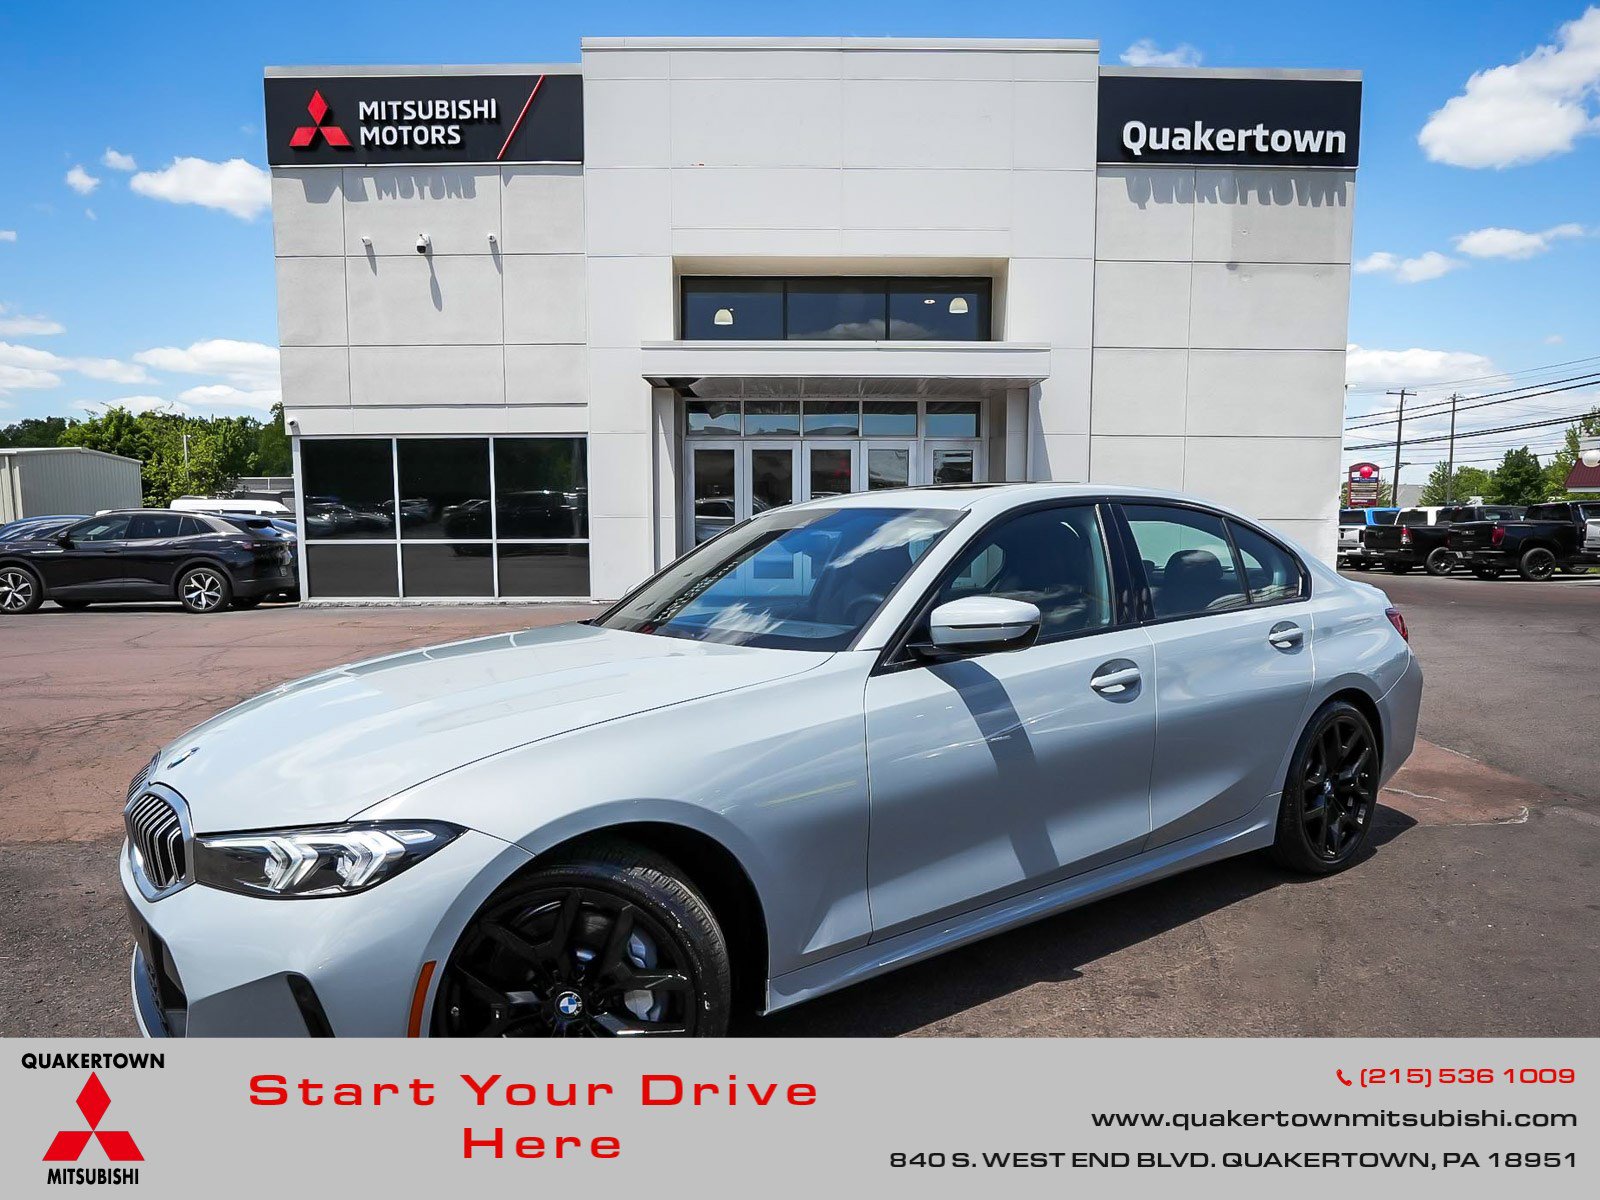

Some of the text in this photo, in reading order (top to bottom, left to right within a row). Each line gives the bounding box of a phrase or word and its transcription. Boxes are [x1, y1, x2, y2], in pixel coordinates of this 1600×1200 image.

[358, 98, 497, 120] MITSUBISHI
[359, 124, 461, 146] MOTORS
[1122, 120, 1346, 156] Quakertown
